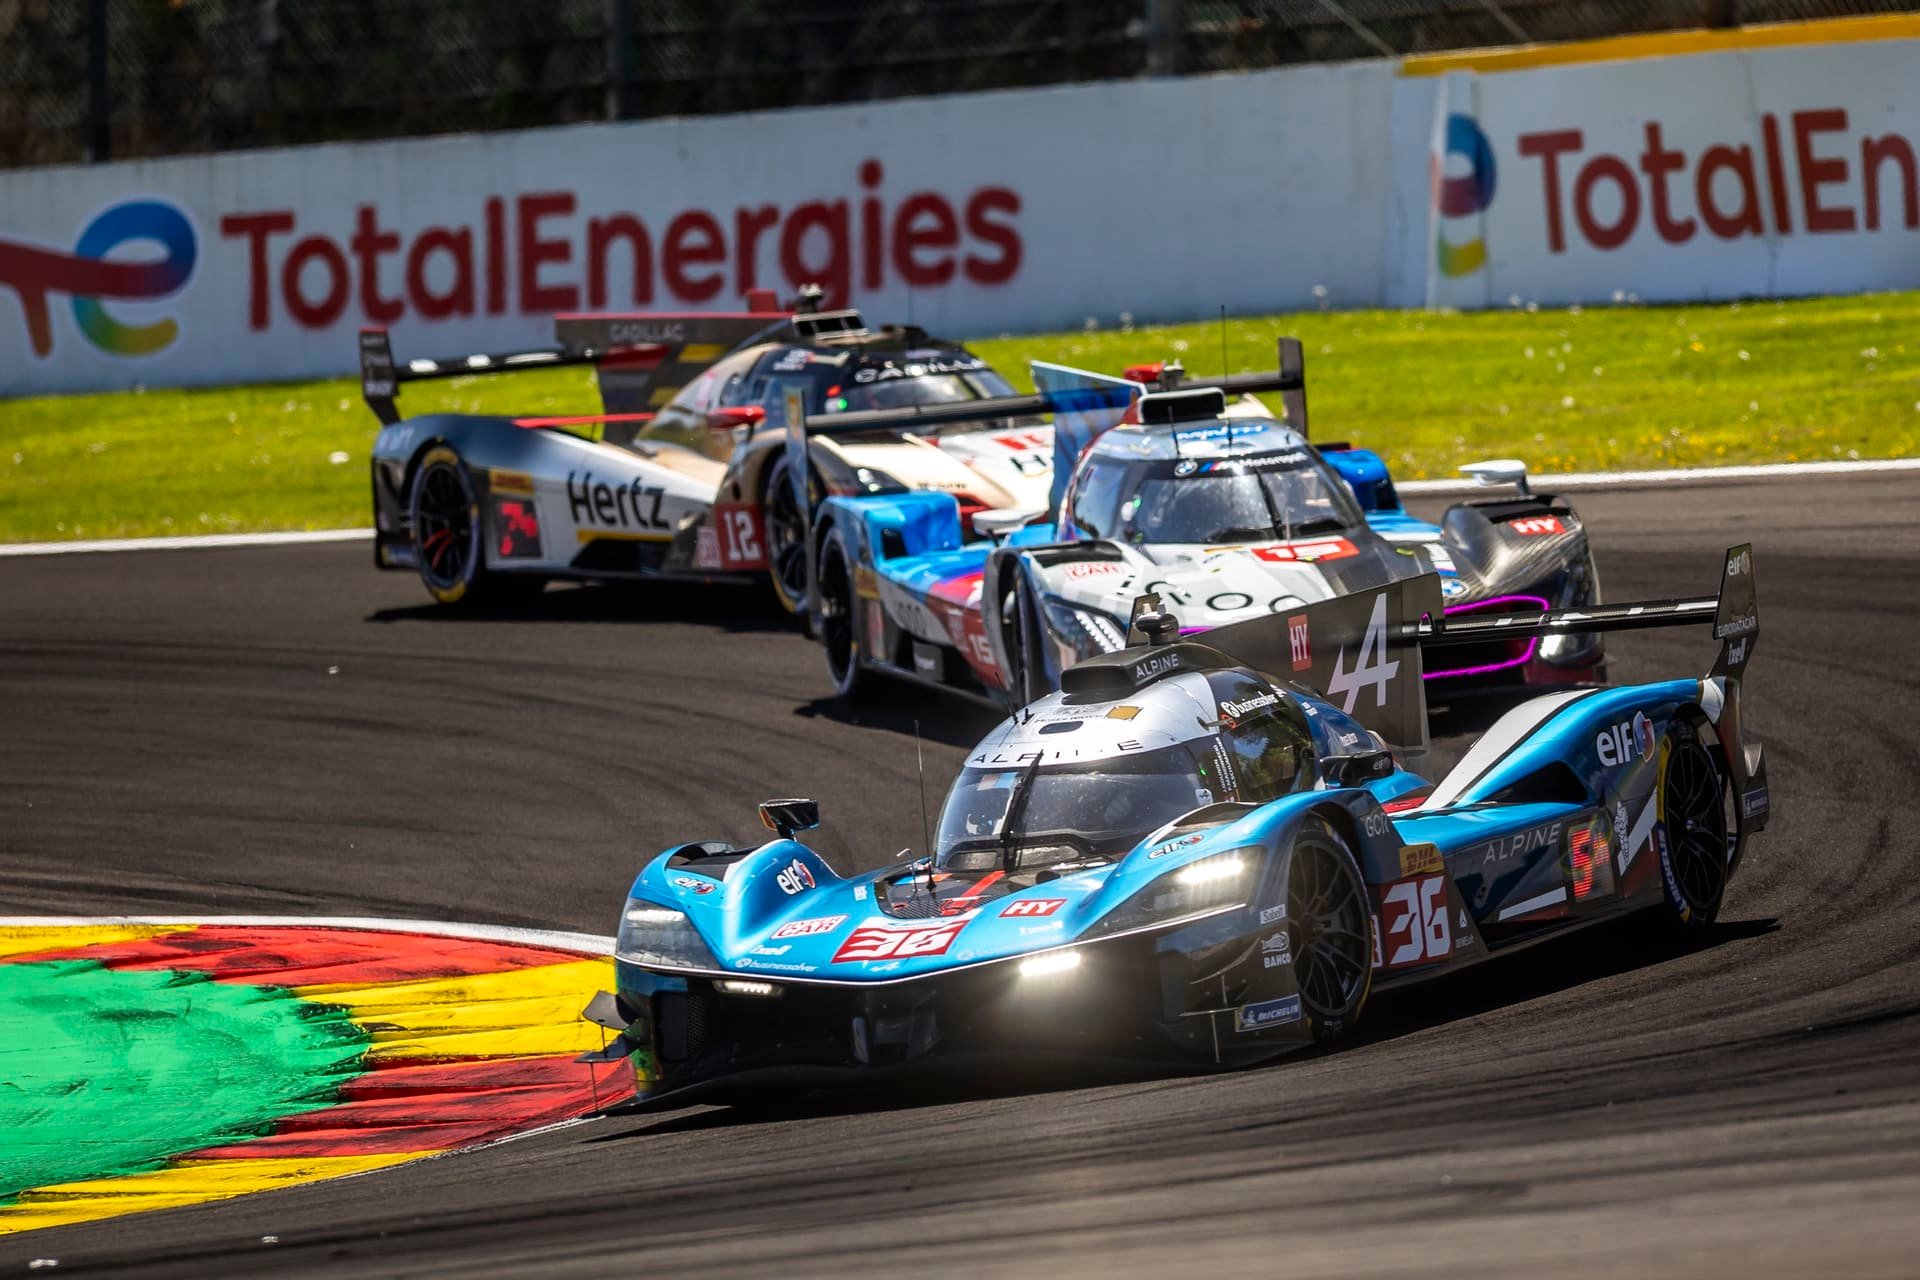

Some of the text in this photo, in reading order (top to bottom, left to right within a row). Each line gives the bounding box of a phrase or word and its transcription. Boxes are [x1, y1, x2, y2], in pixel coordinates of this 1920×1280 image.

[221, 159, 1022, 330] TotalEnergies
[567, 470, 671, 531] Hertz
[724, 510, 761, 561] 12
[1514, 518, 1557, 533] HY
[1727, 556, 1741, 576] elf
[969, 633, 996, 665] 15
[1290, 624, 1308, 662] HY
[1136, 653, 1180, 678] ALPINE
[973, 740, 1143, 764] ALPIE
[1596, 721, 1632, 767] elf
[1148, 841, 1182, 859] elf
[1483, 823, 1561, 864] ALPINE
[1406, 847, 1442, 873] DHL
[674, 877, 702, 891] elf
[776, 867, 804, 895] elf
[1006, 900, 1058, 915] HY
[1384, 876, 1451, 965] 36
[838, 922, 966, 959] 36
[1264, 953, 1292, 968] BAHCO
[1257, 1004, 1298, 1022] MICHELIN
